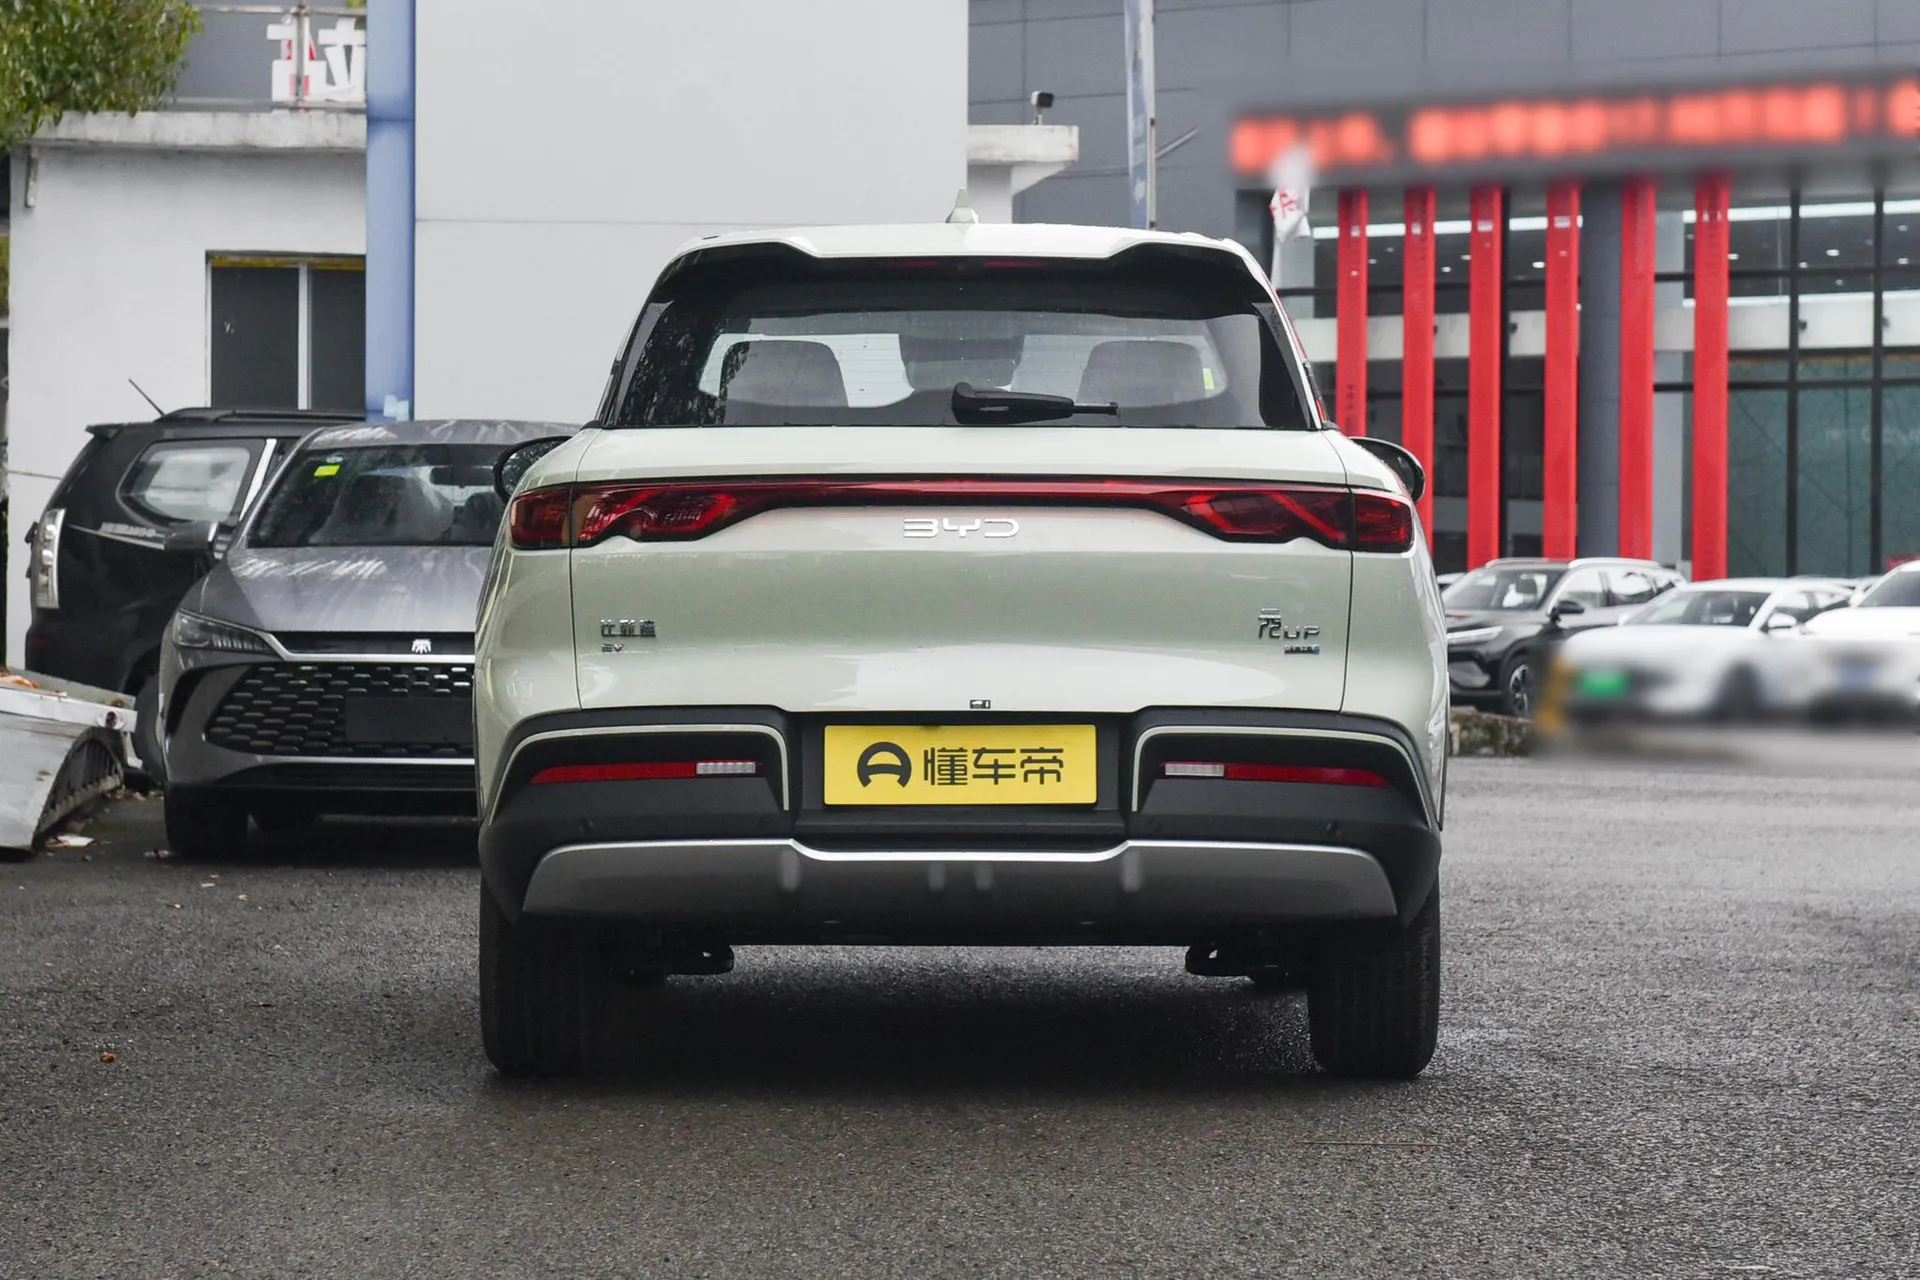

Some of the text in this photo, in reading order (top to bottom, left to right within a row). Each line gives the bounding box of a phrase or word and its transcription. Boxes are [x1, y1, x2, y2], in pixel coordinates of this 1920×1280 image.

[903, 517, 1020, 538] BYD
[923, 747, 1064, 786] 懂车帝
